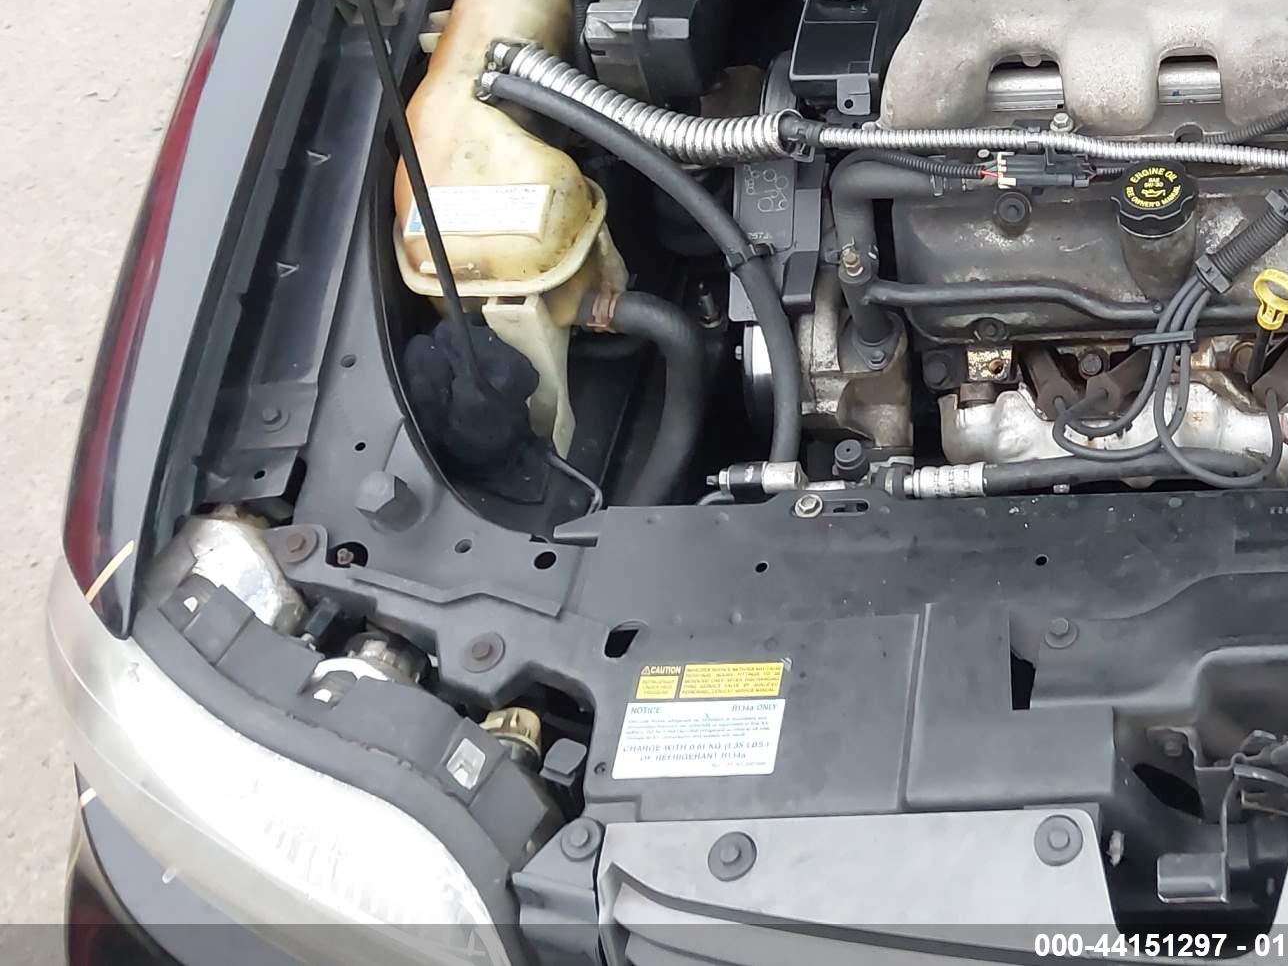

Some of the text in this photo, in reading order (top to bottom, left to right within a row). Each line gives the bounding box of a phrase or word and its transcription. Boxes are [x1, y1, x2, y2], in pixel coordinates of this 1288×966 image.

[1130, 168, 1178, 183] ENGINE OIL
[1160, 185, 1181, 205] MANUAL
[650, 666, 681, 675] CAUTION
[631, 706, 661, 714] NOTICE
[731, 704, 754, 712] R134a
[623, 745, 661, 753] CHARGE
[664, 743, 687, 752] WITH
[655, 752, 718, 762] REFRIGERANT
